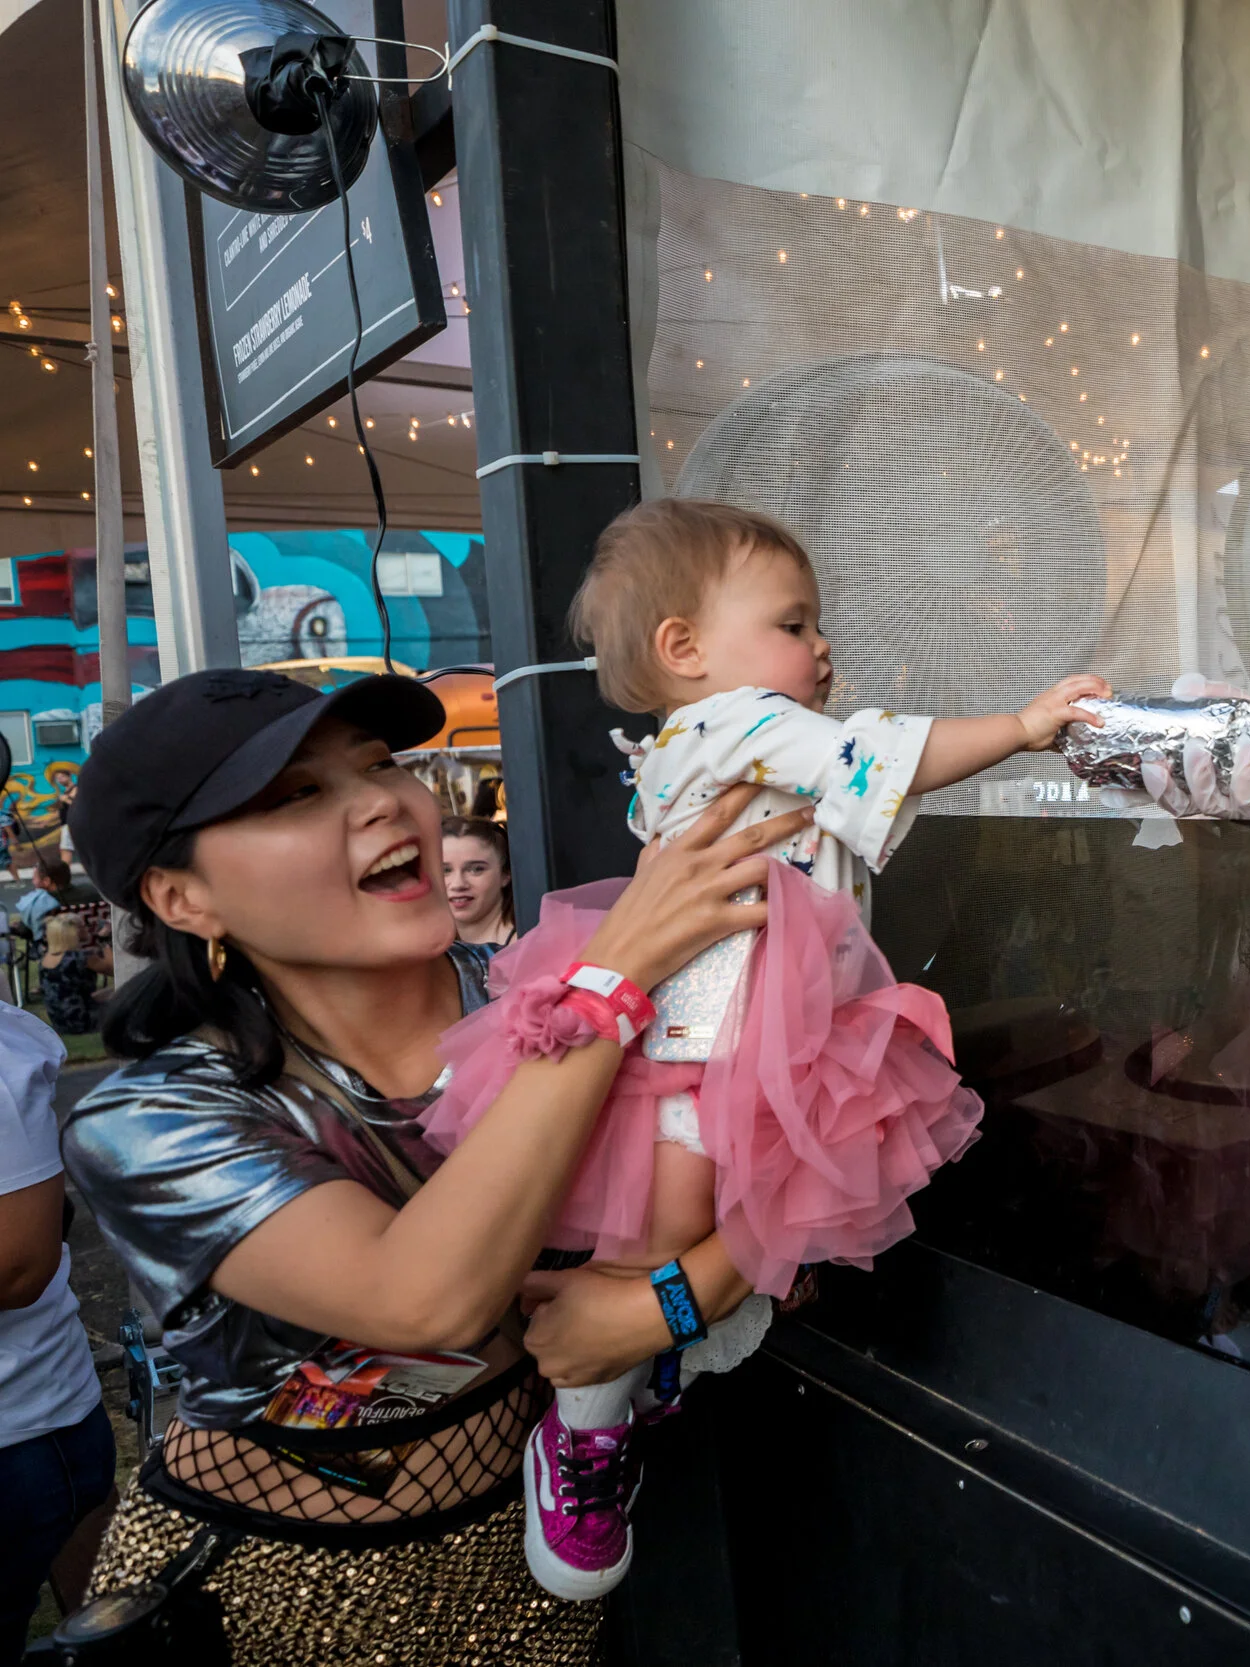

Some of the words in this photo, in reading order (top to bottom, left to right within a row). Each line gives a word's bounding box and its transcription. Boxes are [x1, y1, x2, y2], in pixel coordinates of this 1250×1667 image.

[361, 216, 373, 244] $4
[233, 332, 254, 368] FROZEN
[250, 299, 283, 351] STRAWBERRY
[280, 272, 312, 321] LEMONADE
[358, 1406, 426, 1420] BEAUTIFUL
